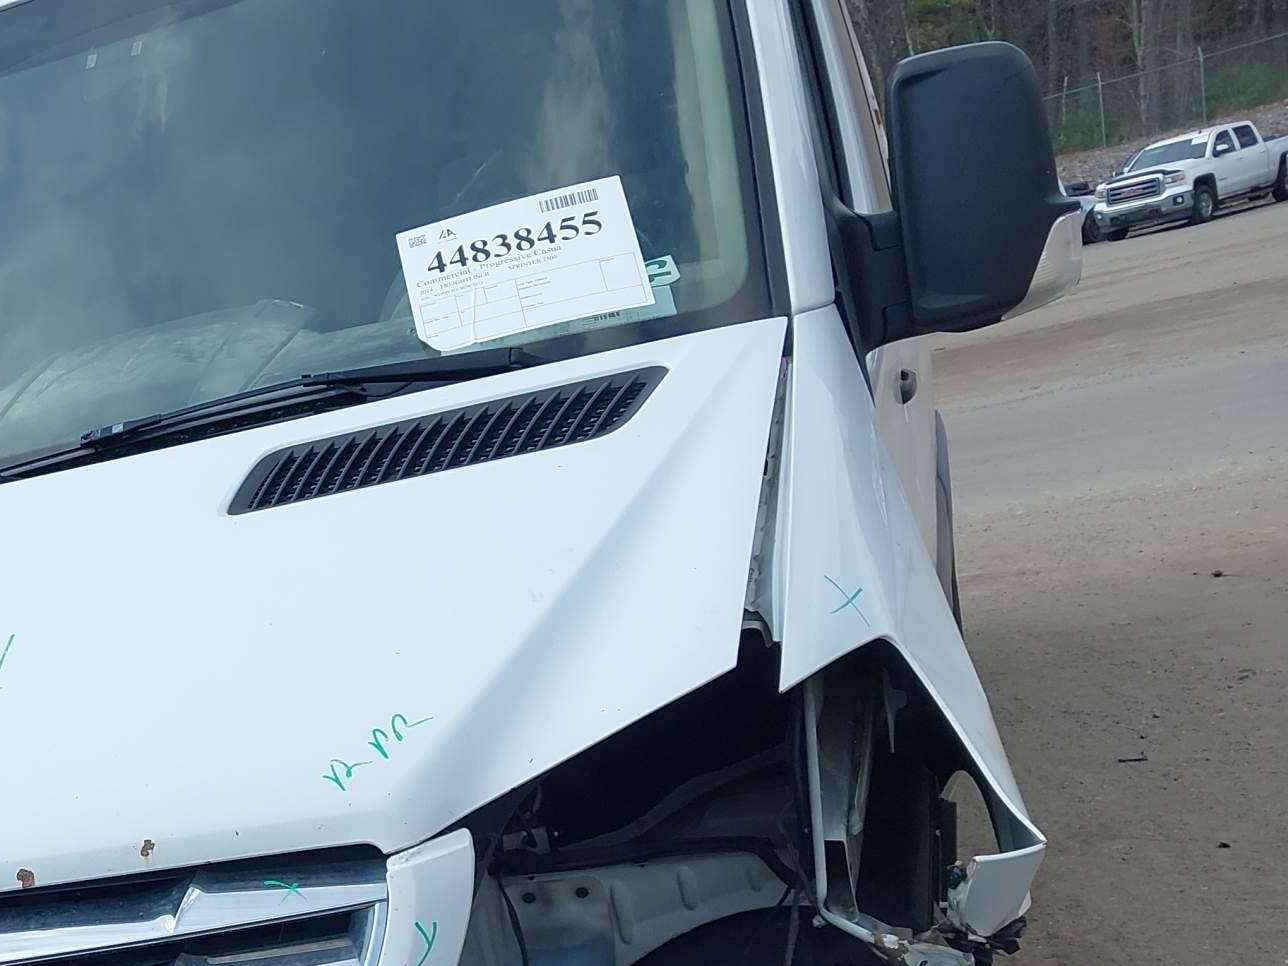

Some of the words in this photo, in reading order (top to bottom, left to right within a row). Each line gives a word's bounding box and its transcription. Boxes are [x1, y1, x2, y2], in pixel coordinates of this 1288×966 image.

[427, 210, 603, 275] 44838455
[416, 266, 472, 288] Commercial
[480, 251, 533, 270] Progressive
